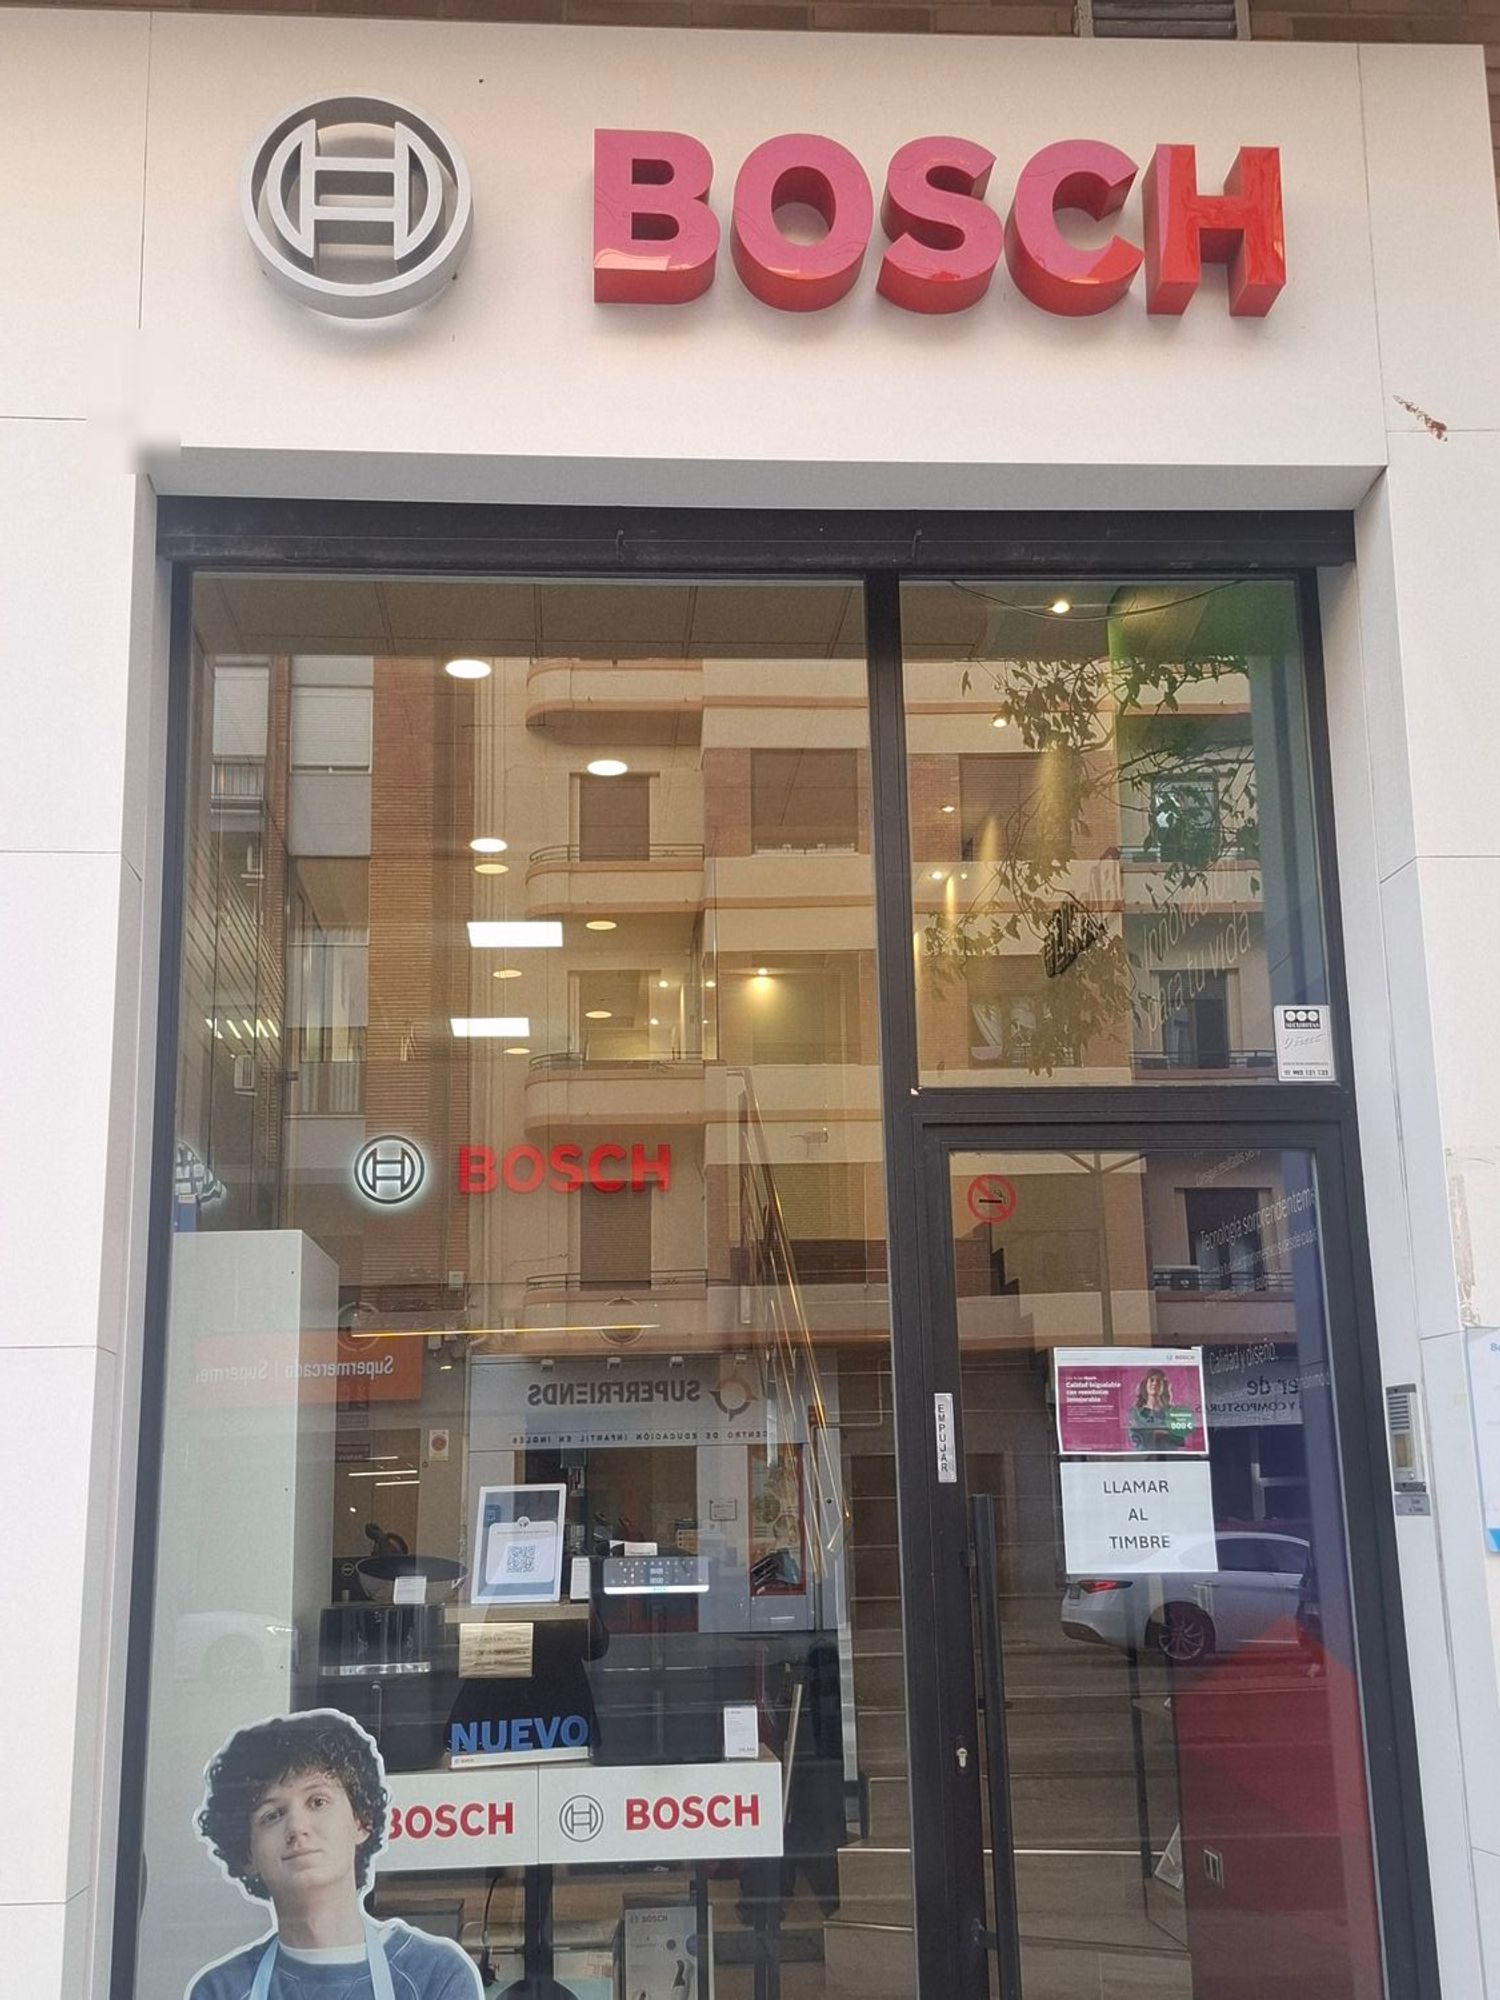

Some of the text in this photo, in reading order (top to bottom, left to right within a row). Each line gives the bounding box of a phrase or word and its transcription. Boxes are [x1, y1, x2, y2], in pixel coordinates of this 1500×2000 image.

[594, 128, 1287, 316] BOSCH
[1149, 904, 1251, 1046] para tu vida
[459, 1143, 672, 1195] BOSCH
[937, 1403, 949, 1473] EMPUJAR
[1103, 1480, 1169, 1494] LLAMAR
[1128, 1507, 1148, 1521] AL
[1108, 1535, 1170, 1549] TIMBRE
[450, 1714, 590, 1755] NUEVO
[625, 1793, 760, 1832] BOSCH
